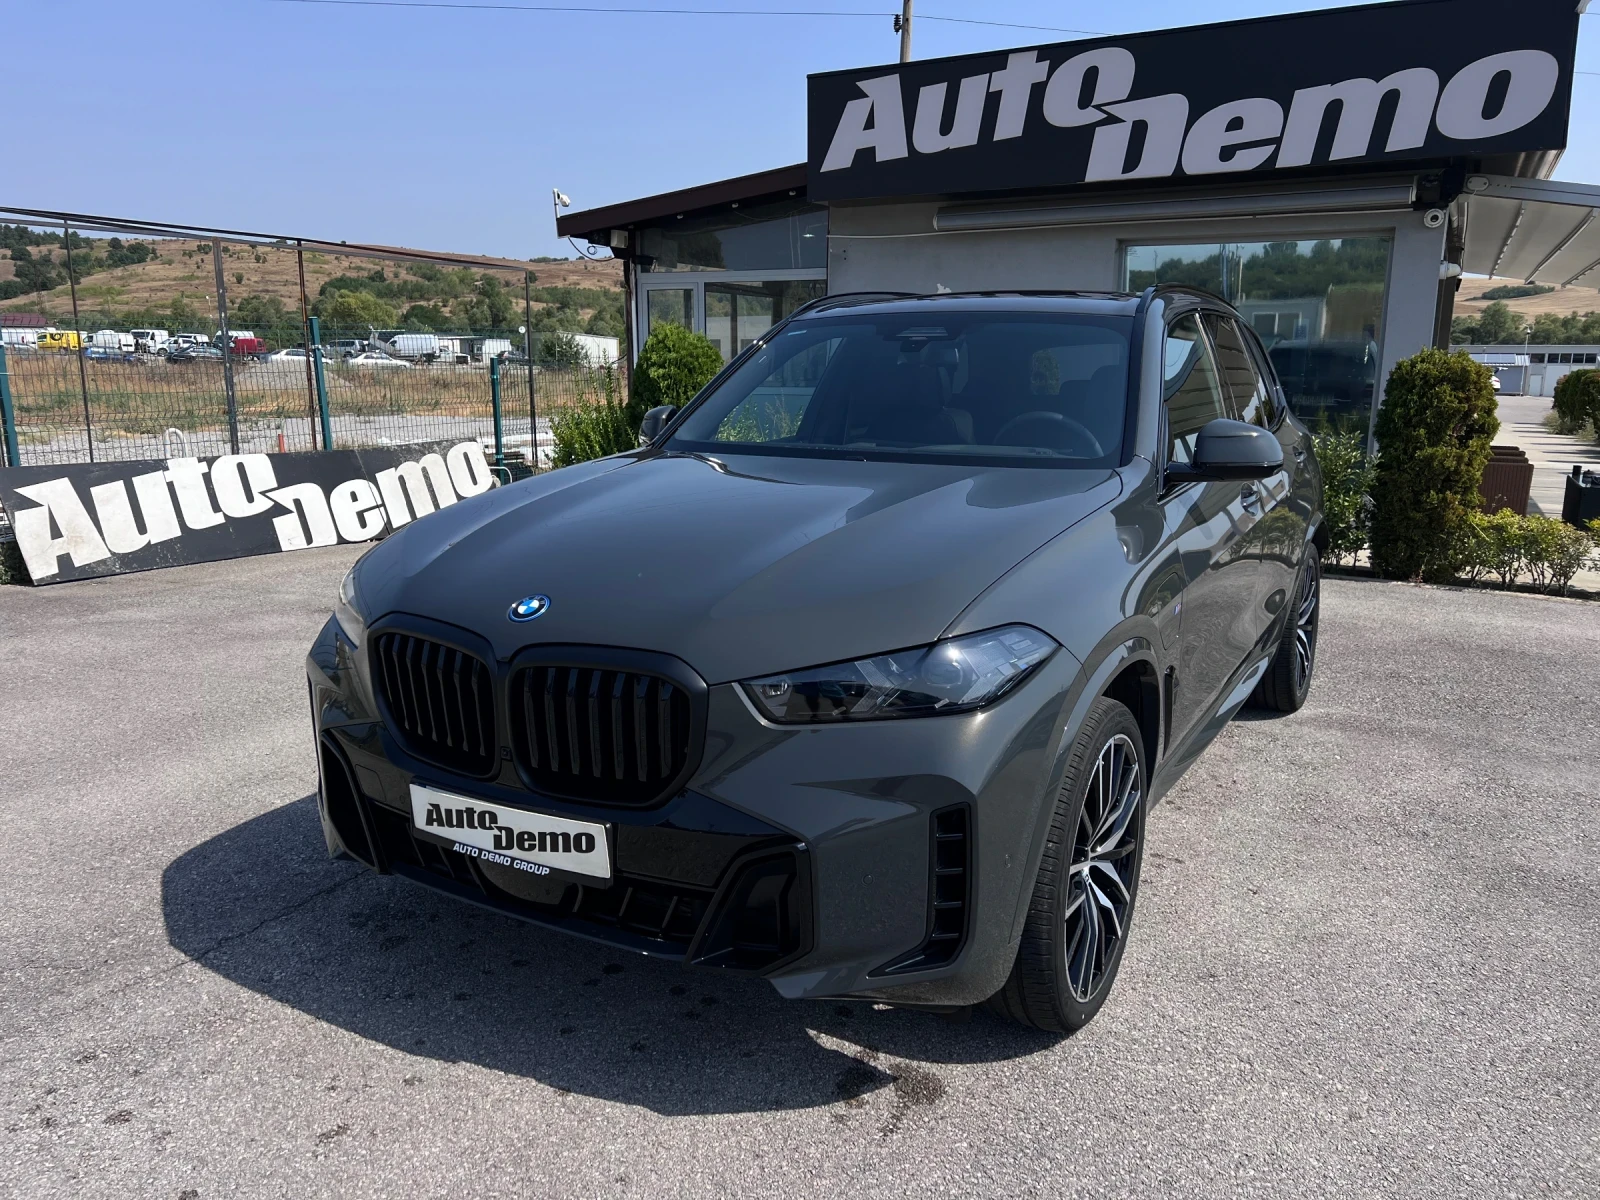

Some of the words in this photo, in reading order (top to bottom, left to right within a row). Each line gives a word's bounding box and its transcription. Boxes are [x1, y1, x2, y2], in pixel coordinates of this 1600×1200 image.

[820, 47, 1137, 173] Auto
[1084, 49, 1559, 182] Demo
[13, 453, 279, 580] Auto
[265, 441, 493, 552] Demo
[425, 803, 498, 830] Auto
[492, 825, 596, 853] Demo
[452, 842, 479, 857] AUTO
[480, 852, 511, 866] DEMO
[513, 859, 550, 876] GROUP
